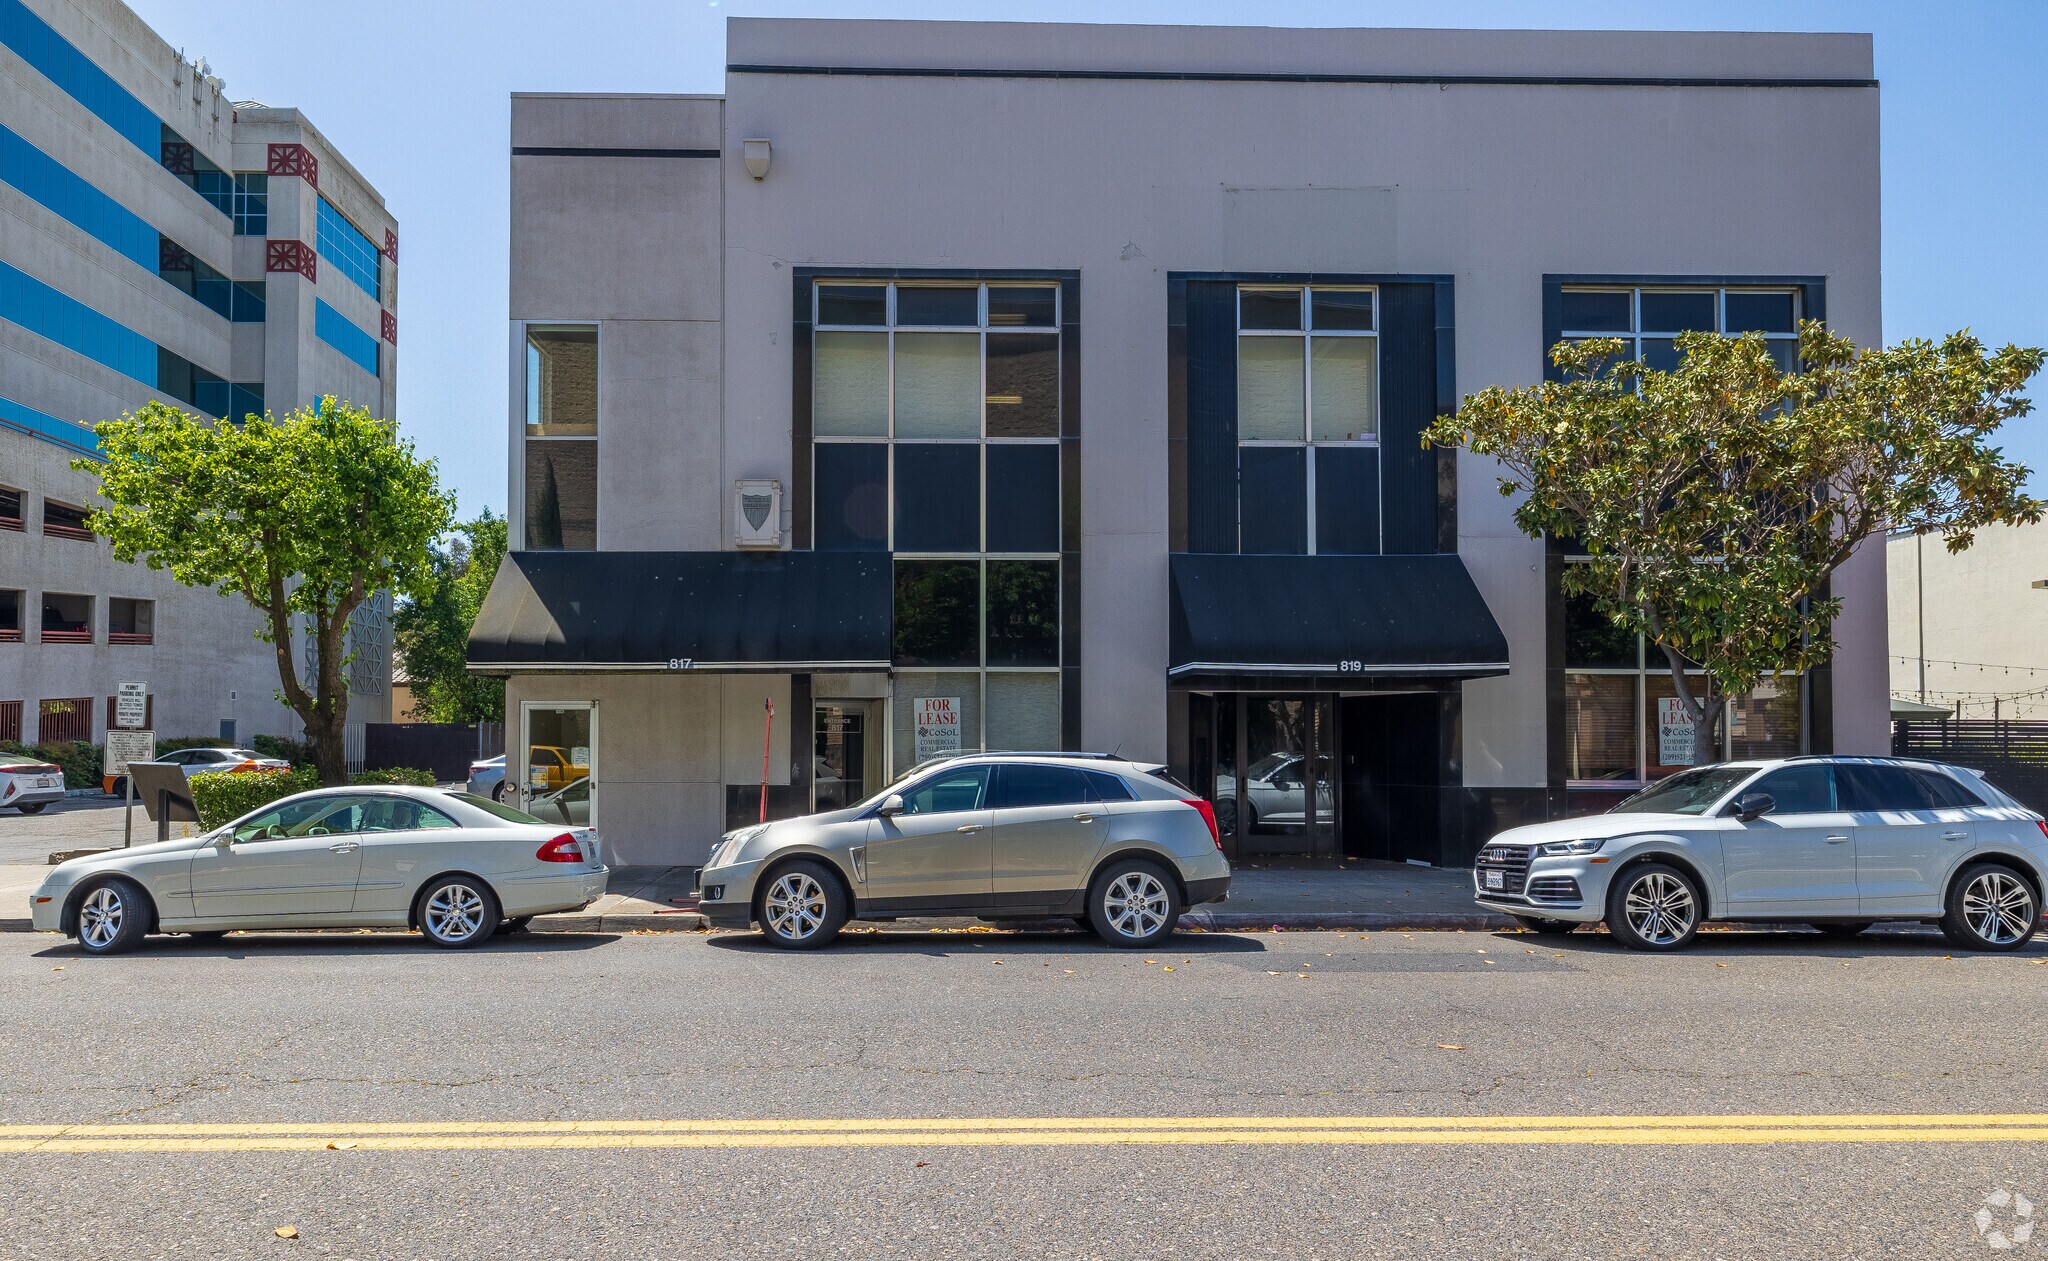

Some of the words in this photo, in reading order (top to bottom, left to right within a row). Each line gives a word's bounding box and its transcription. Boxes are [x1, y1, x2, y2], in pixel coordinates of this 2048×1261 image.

[670, 658, 692, 669] 817
[1340, 660, 1362, 671] 819
[925, 698, 951, 711] FOR
[1669, 699, 1686, 712] FO
[918, 711, 958, 725] LEASE
[1662, 712, 1694, 724] LEAS
[1672, 728, 1695, 736] CoSo
